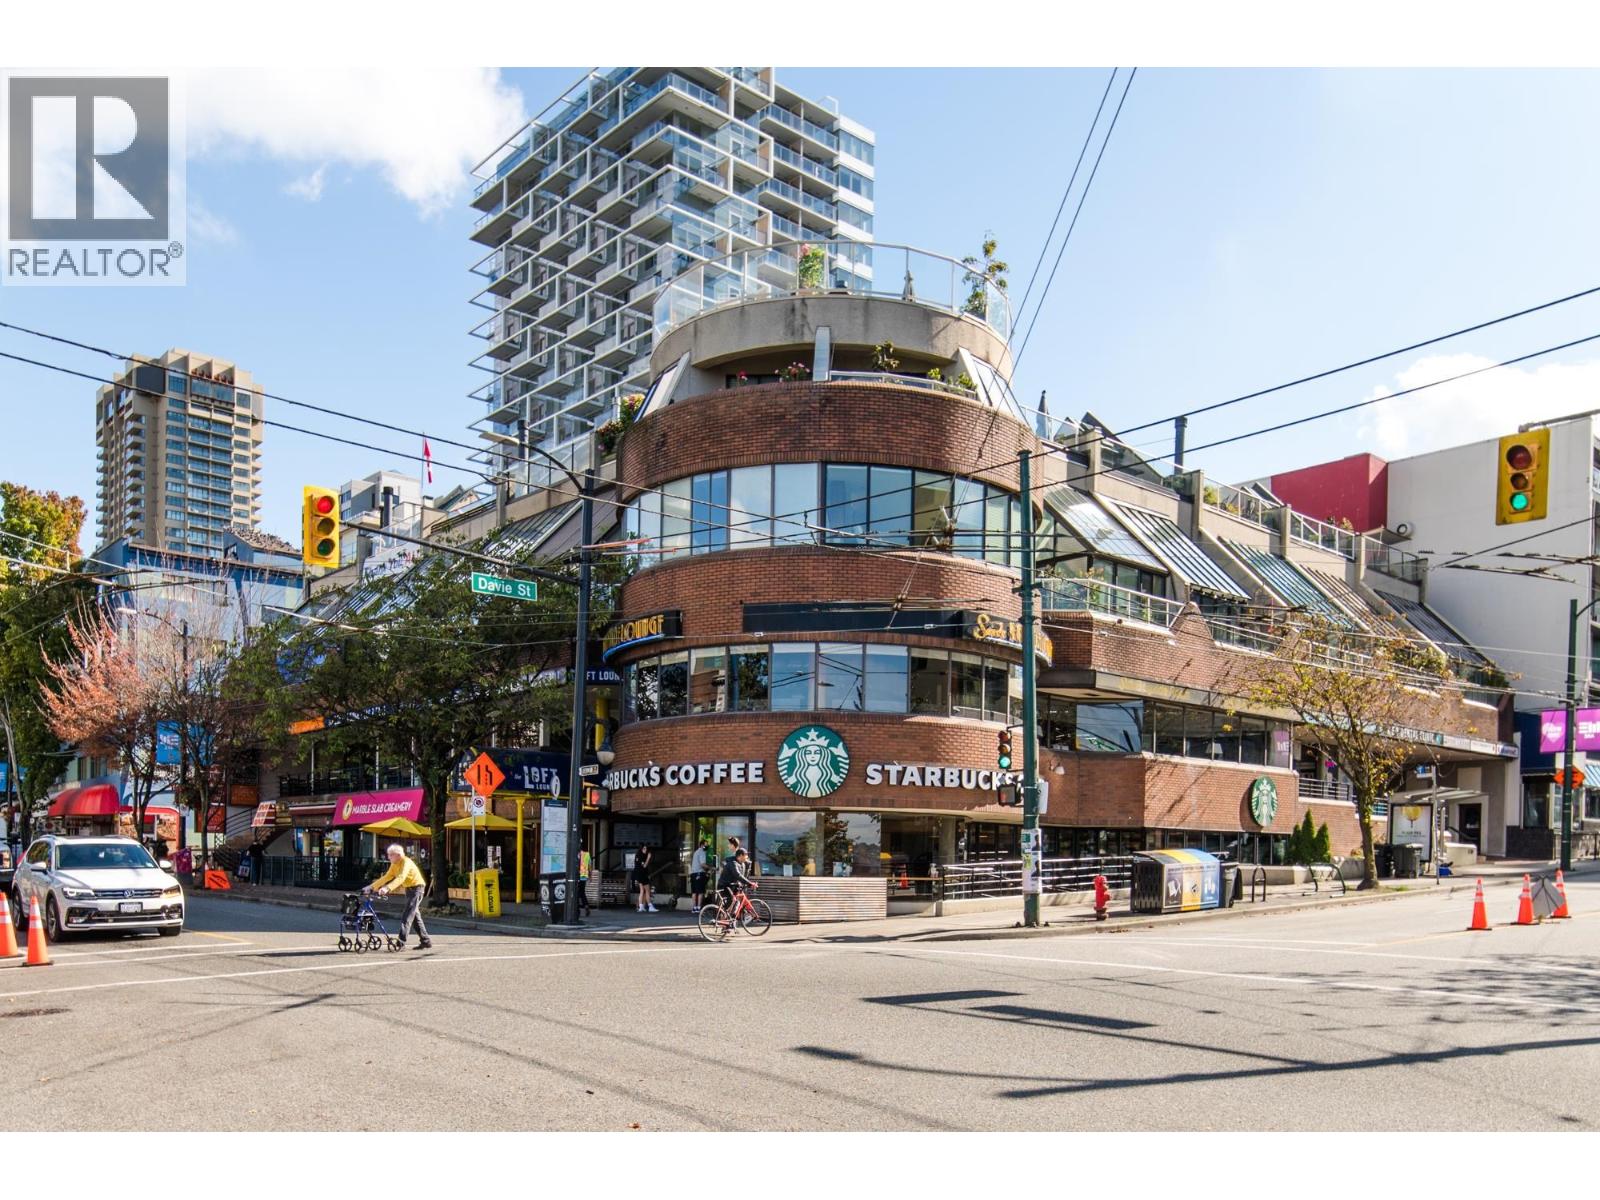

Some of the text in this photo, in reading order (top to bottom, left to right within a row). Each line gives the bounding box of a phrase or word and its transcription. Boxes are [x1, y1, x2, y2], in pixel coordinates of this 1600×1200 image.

[478, 577, 532, 597] Davie St
[523, 765, 558, 789] LOFT
[665, 762, 763, 786] COFFEE
[352, 801, 412, 814] MARBLE SLAB CREAMERY
